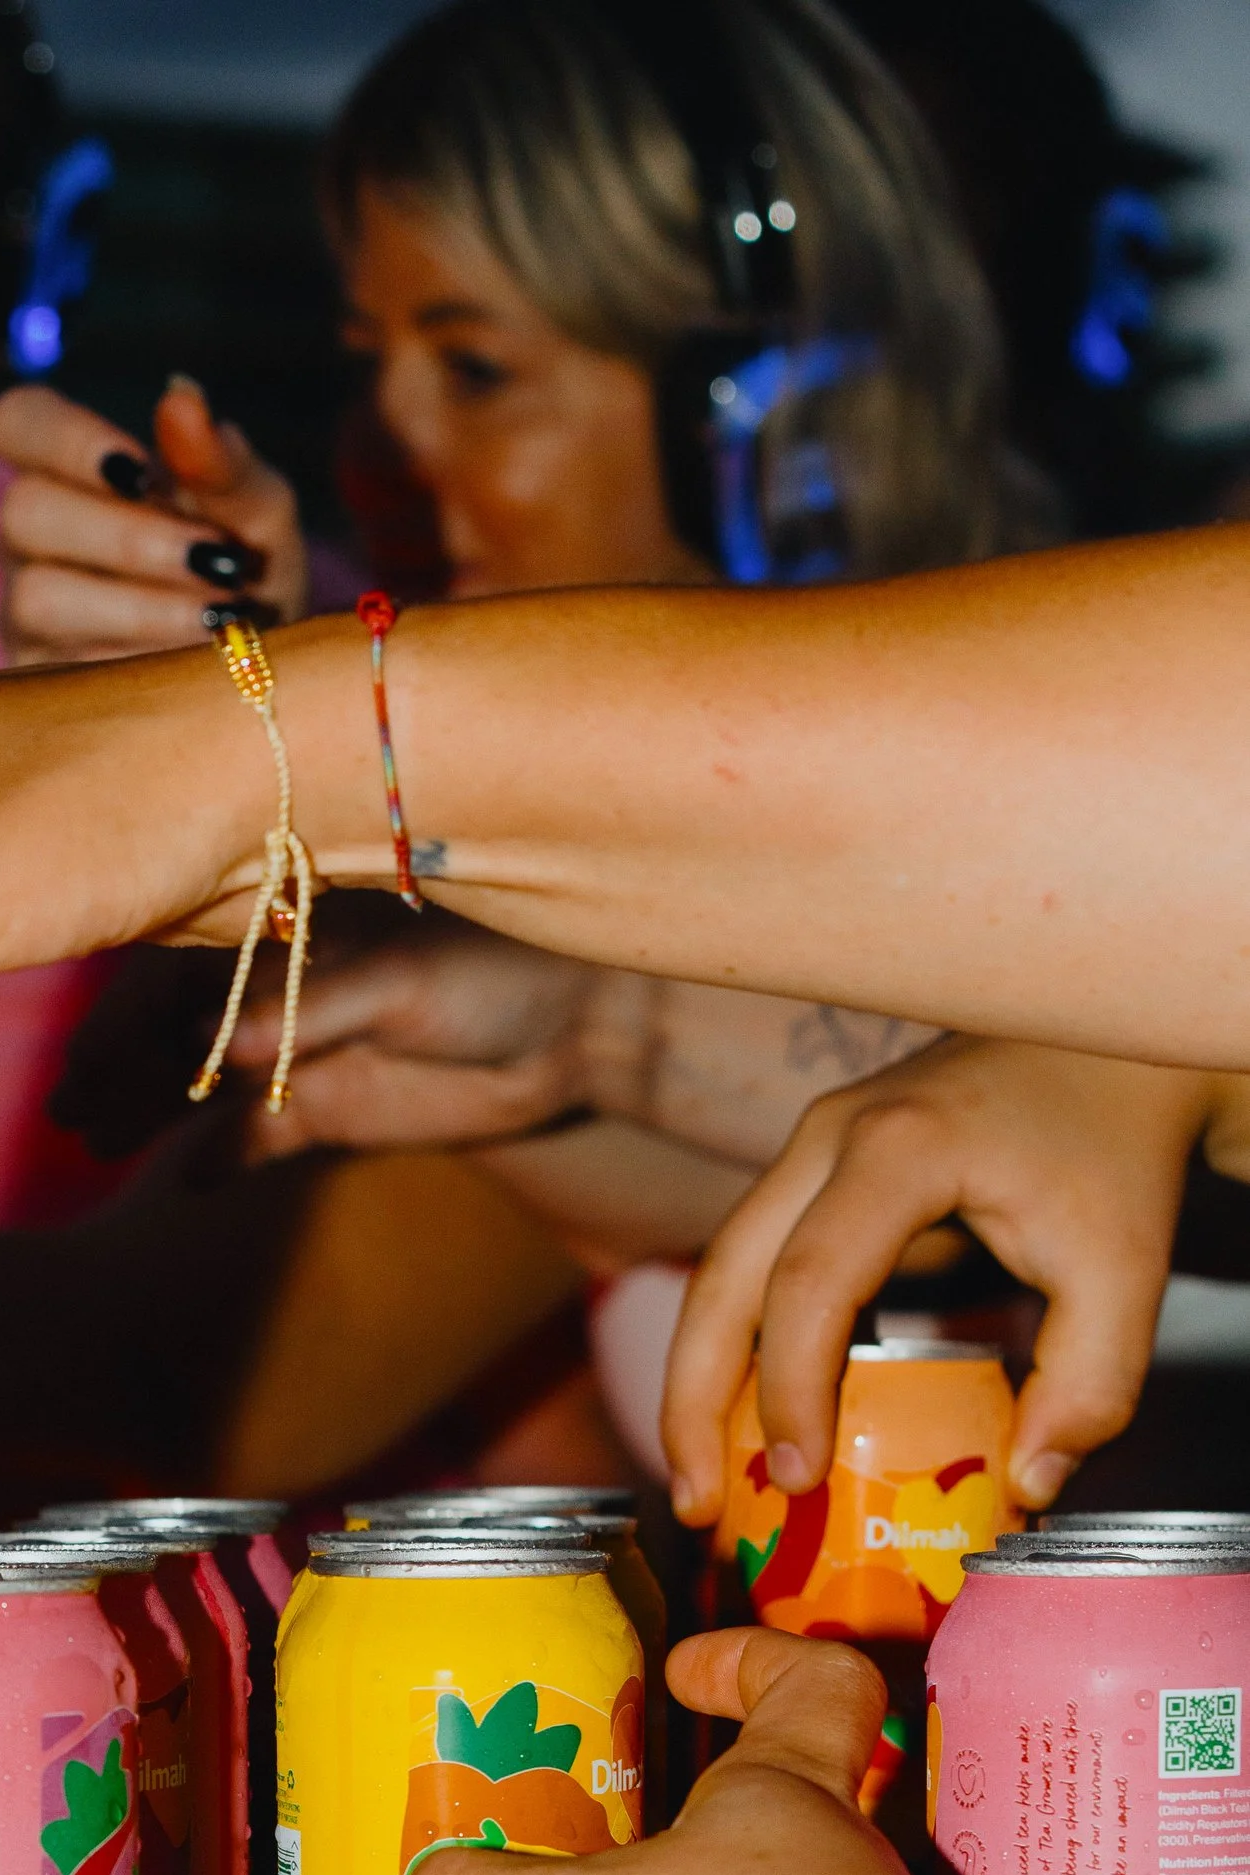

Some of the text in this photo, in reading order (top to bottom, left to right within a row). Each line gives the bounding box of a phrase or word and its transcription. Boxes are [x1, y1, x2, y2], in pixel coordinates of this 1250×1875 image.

[864, 1516, 969, 1550] Dilmah
[1062, 1700, 1078, 1740] those
[139, 1755, 186, 1791] ilmah
[592, 1759, 641, 1795] Dilm
[1064, 1746, 1078, 1774] with
[1015, 1722, 1032, 1875] iced tea helps make
[1036, 1760, 1055, 1815] Growers
[1060, 1782, 1080, 1830] shared
[1038, 1822, 1051, 1850] Tea
[1090, 1824, 1100, 1844] our
[1117, 1836, 1126, 1853] an
[1038, 1858, 1052, 1871] of
[1064, 1838, 1082, 1875] being
[1086, 1851, 1102, 1870] for
